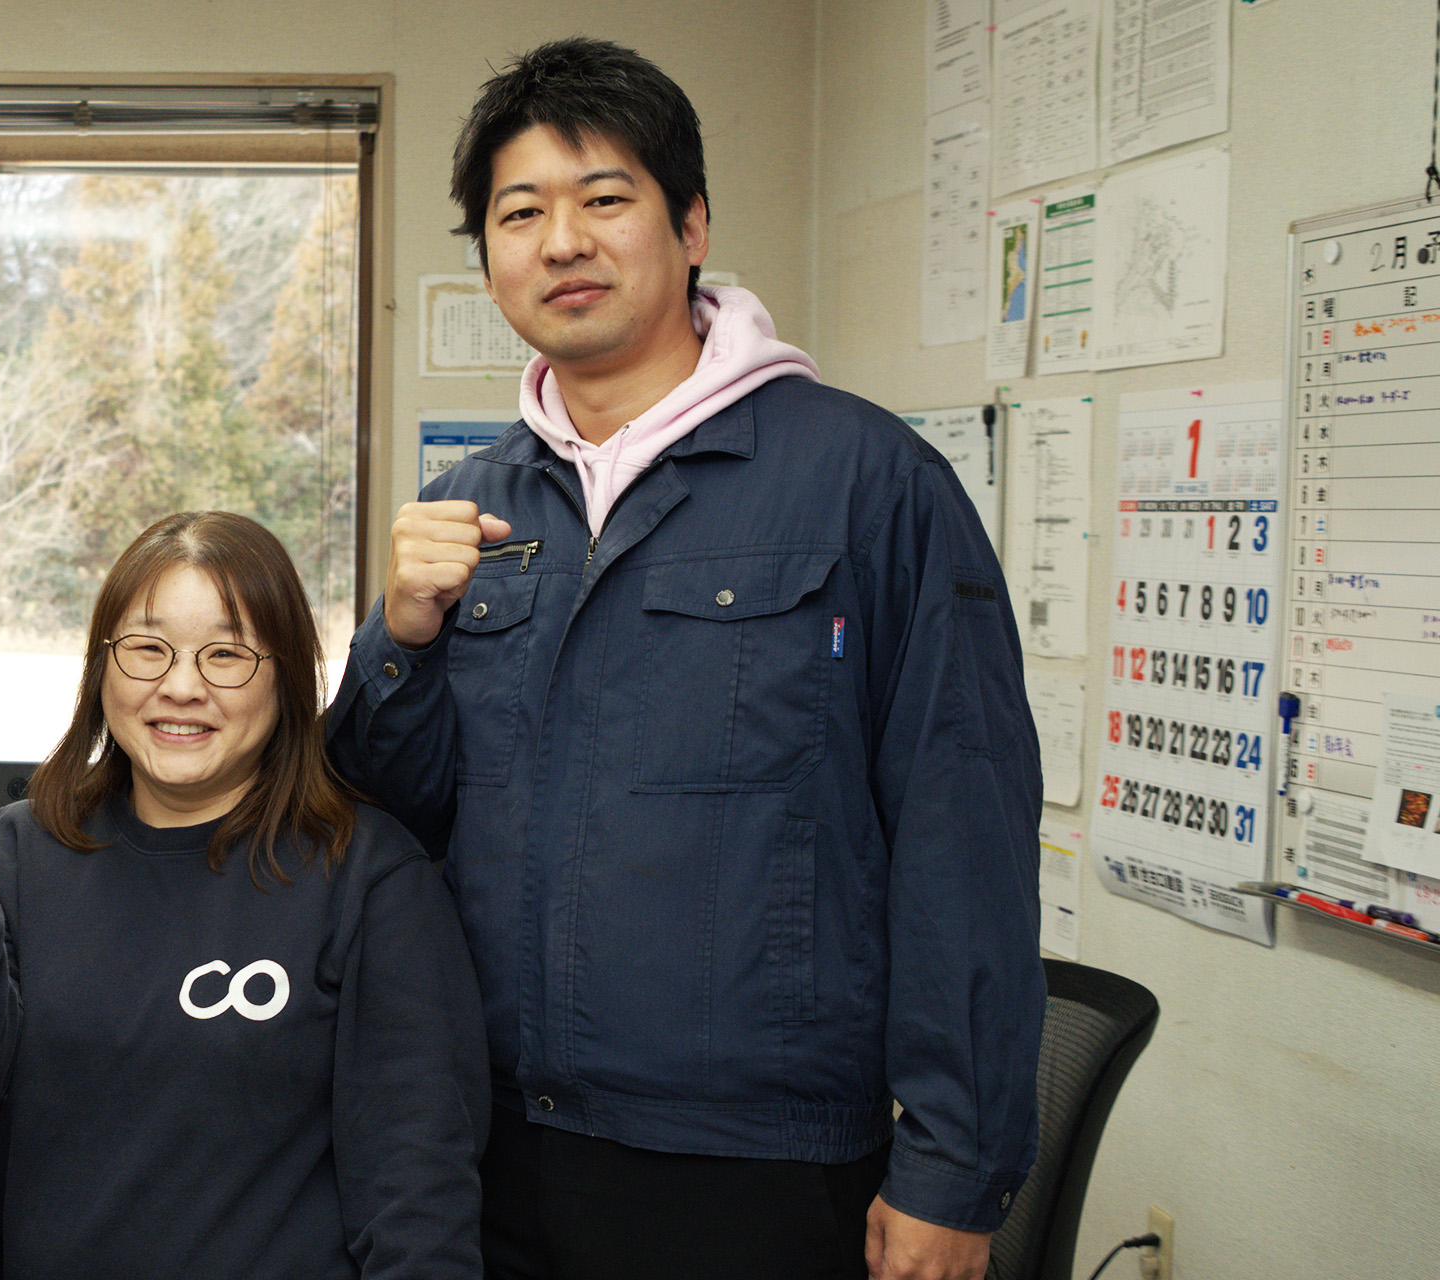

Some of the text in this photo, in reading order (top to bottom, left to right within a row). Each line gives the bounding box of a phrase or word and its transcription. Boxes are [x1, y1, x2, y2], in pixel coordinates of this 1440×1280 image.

[1369, 242, 1386, 272] 2
[1391, 236, 1407, 269] 月
[1306, 301, 1315, 319] 日
[1187, 419, 1202, 478] 1
[1206, 515, 1215, 549] 1
[1228, 515, 1241, 550] 2
[1252, 515, 1268, 551] 3
[1117, 580, 1268, 625] 4 5 6 7 8 9 10
[1113, 645, 1265, 697] 11 12 13 14 15 16 17
[1108, 710, 1262, 771] 18 19 20 21 22 23 24
[1101, 774, 1255, 843] 25 26 27 28 29 30 31
